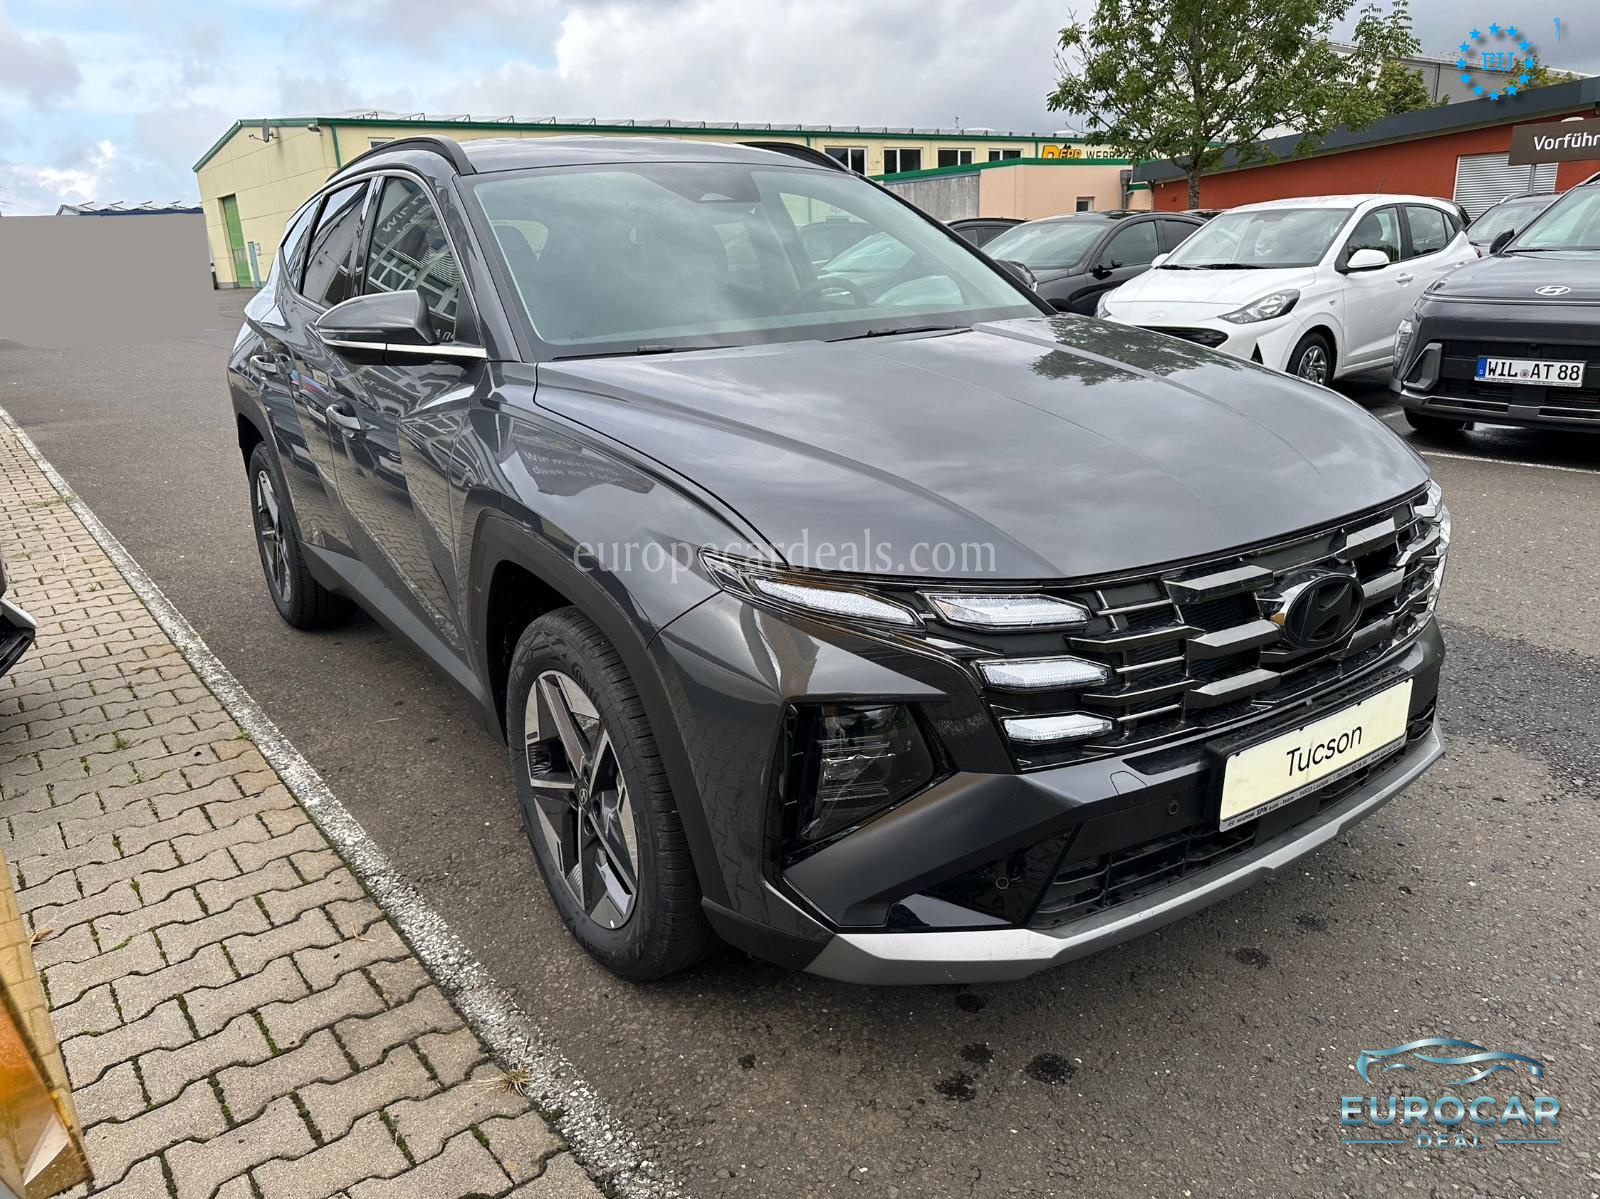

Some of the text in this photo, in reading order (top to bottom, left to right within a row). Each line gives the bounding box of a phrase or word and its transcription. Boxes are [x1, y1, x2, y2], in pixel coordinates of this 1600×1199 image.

[1488, 361, 1581, 381] WIL AT 88
[1286, 725, 1362, 777] Tucson
[1256, 805, 1268, 816] SPN
